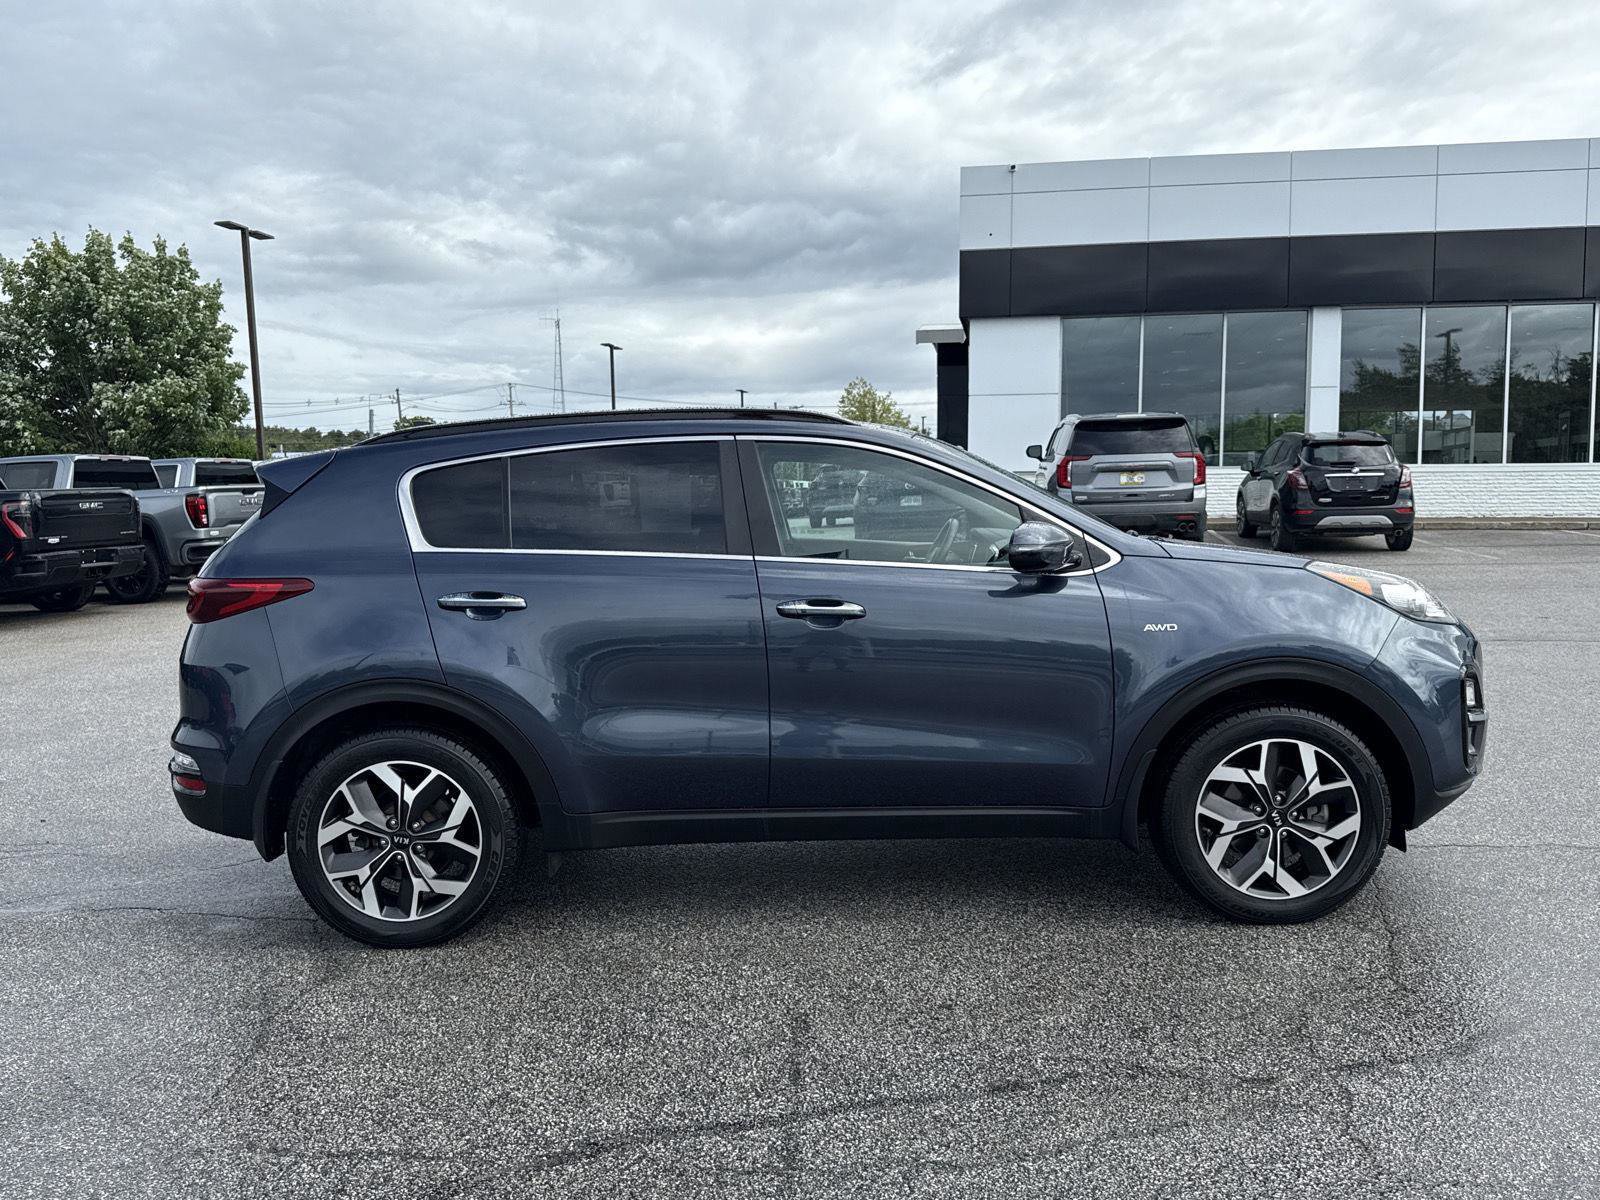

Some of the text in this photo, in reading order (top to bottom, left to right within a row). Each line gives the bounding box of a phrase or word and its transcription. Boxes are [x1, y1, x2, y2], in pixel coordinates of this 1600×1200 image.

[1143, 623, 1178, 632] AWD
[1271, 810, 1283, 827] KIA
[393, 836, 410, 845] KIA
